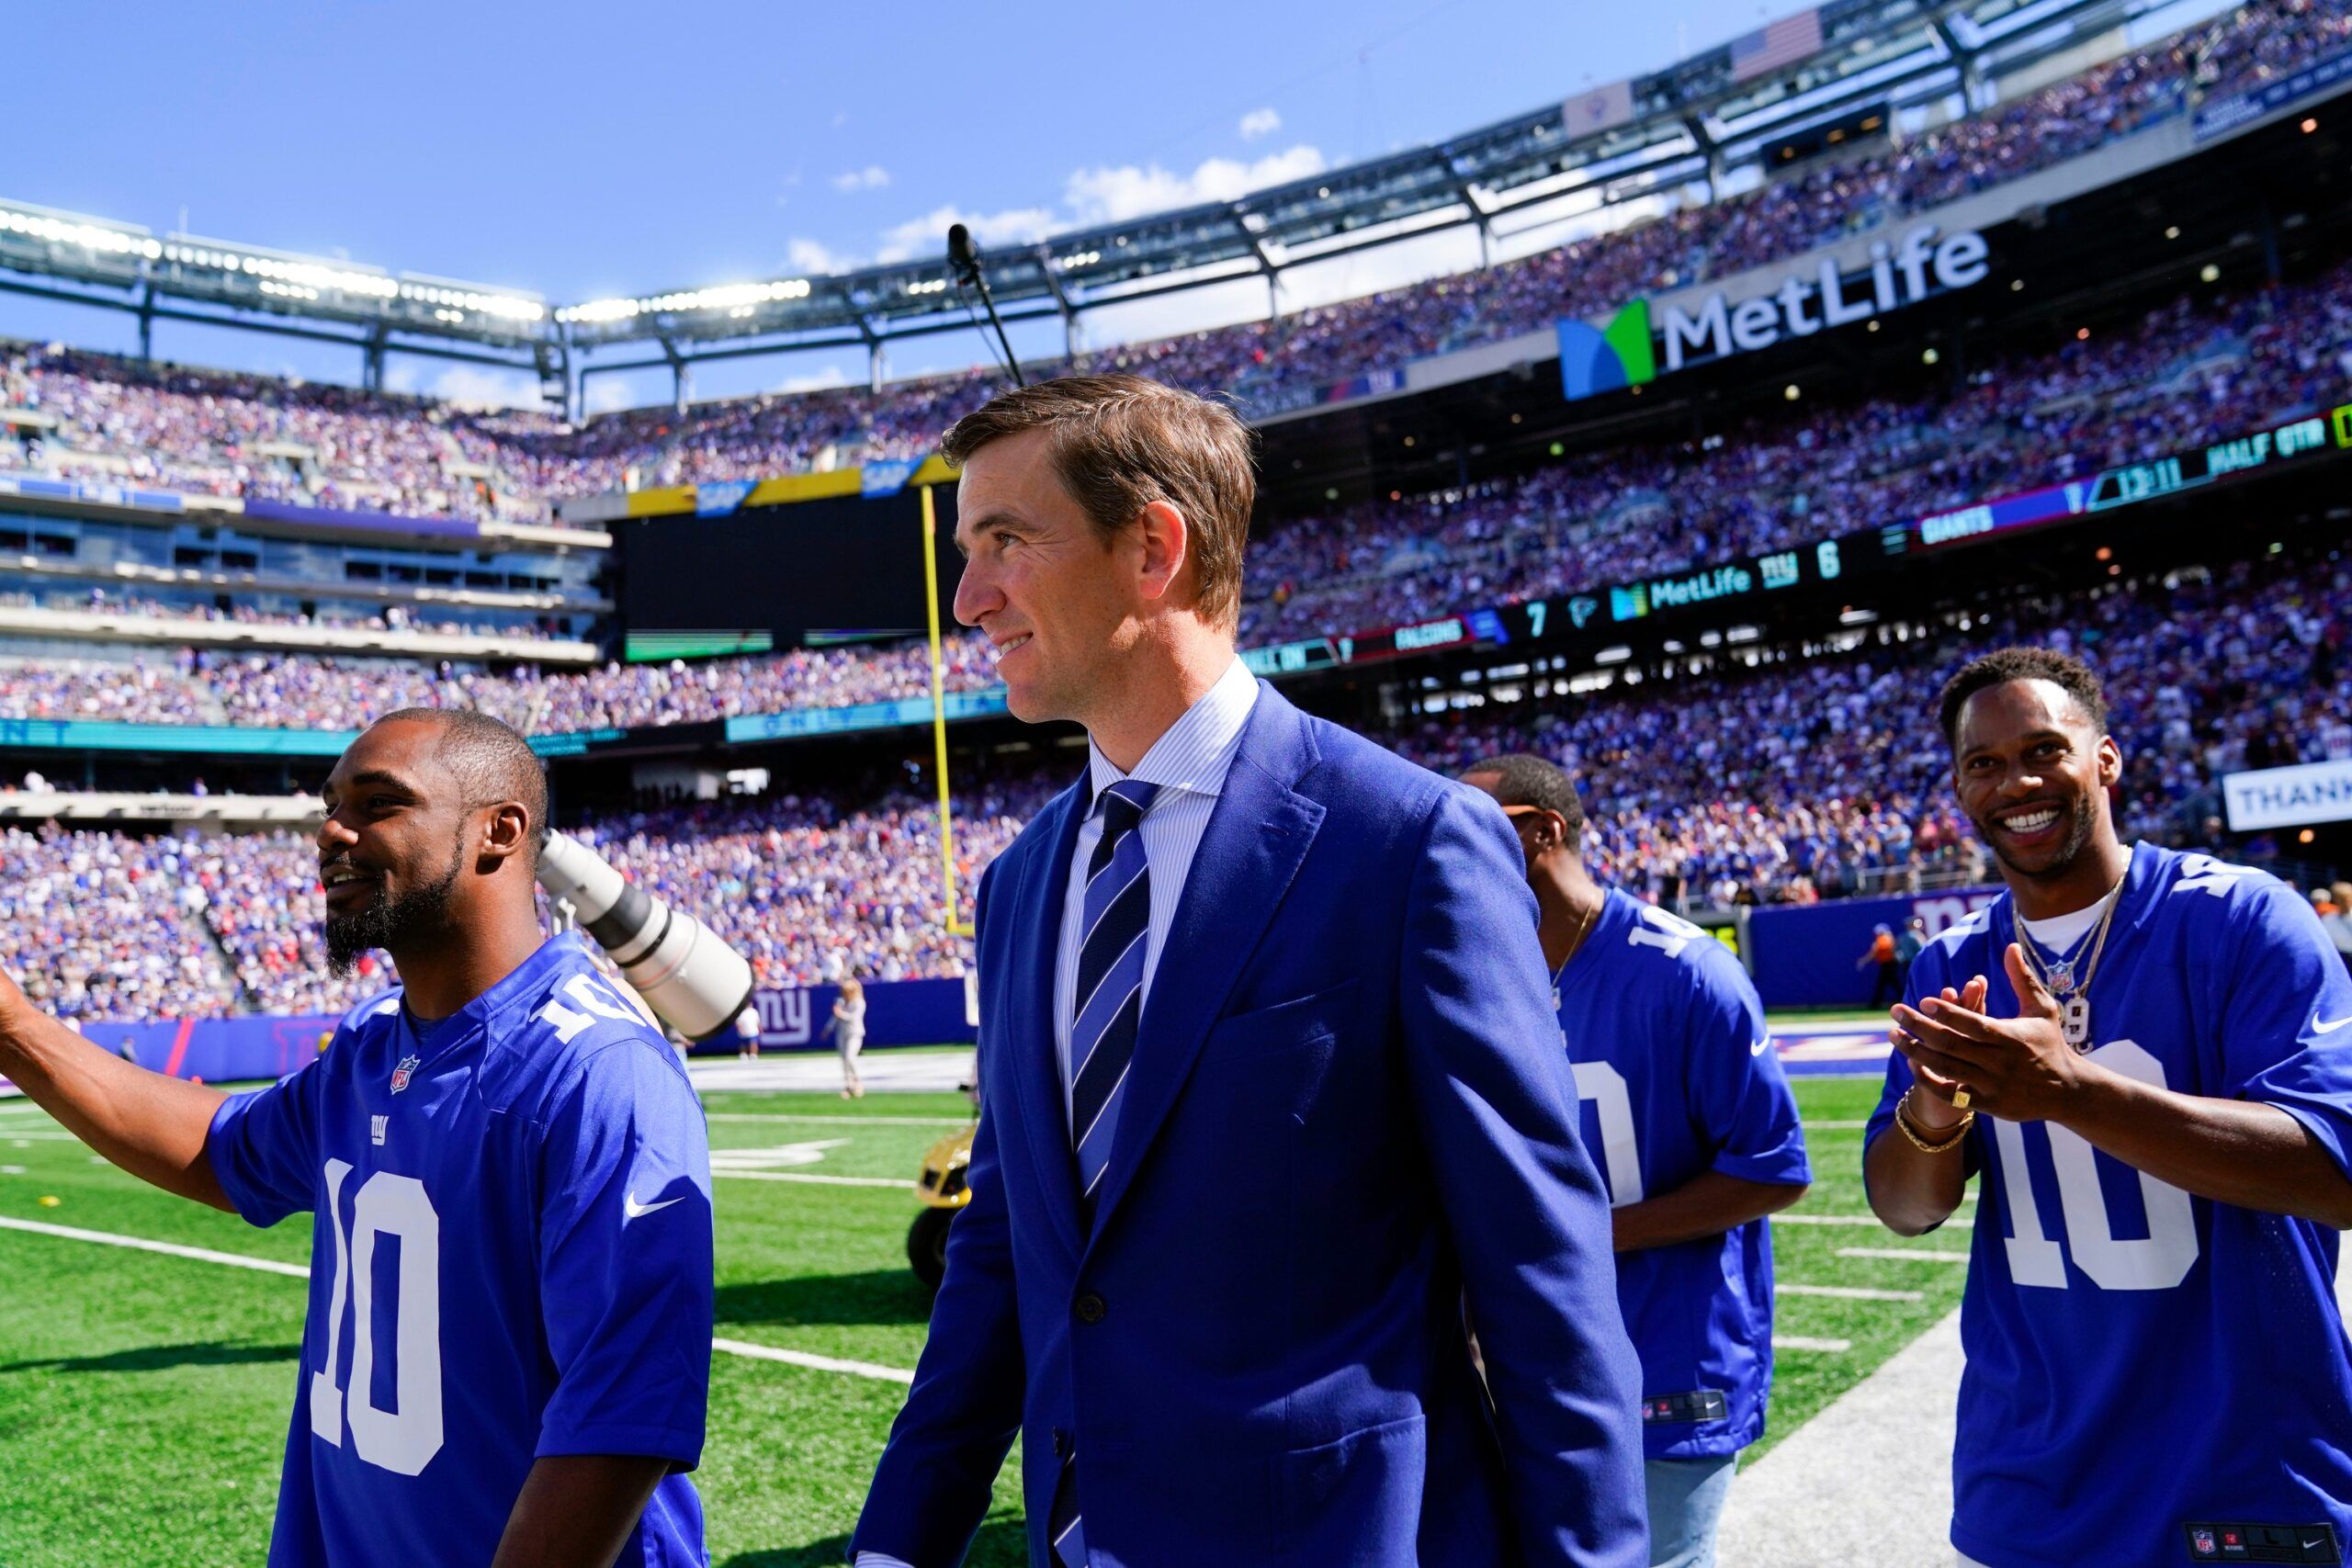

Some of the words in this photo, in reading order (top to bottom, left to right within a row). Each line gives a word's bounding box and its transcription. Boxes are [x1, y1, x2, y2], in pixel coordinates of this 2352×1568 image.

[1664, 226, 1990, 371] MetLife
[1651, 565, 1752, 609] MetLife
[1816, 540, 1841, 581] 6
[1526, 602, 1547, 637] 7
[1628, 906, 1709, 959] 10
[528, 974, 647, 1045] 10
[310, 1157, 445, 1477] 10
